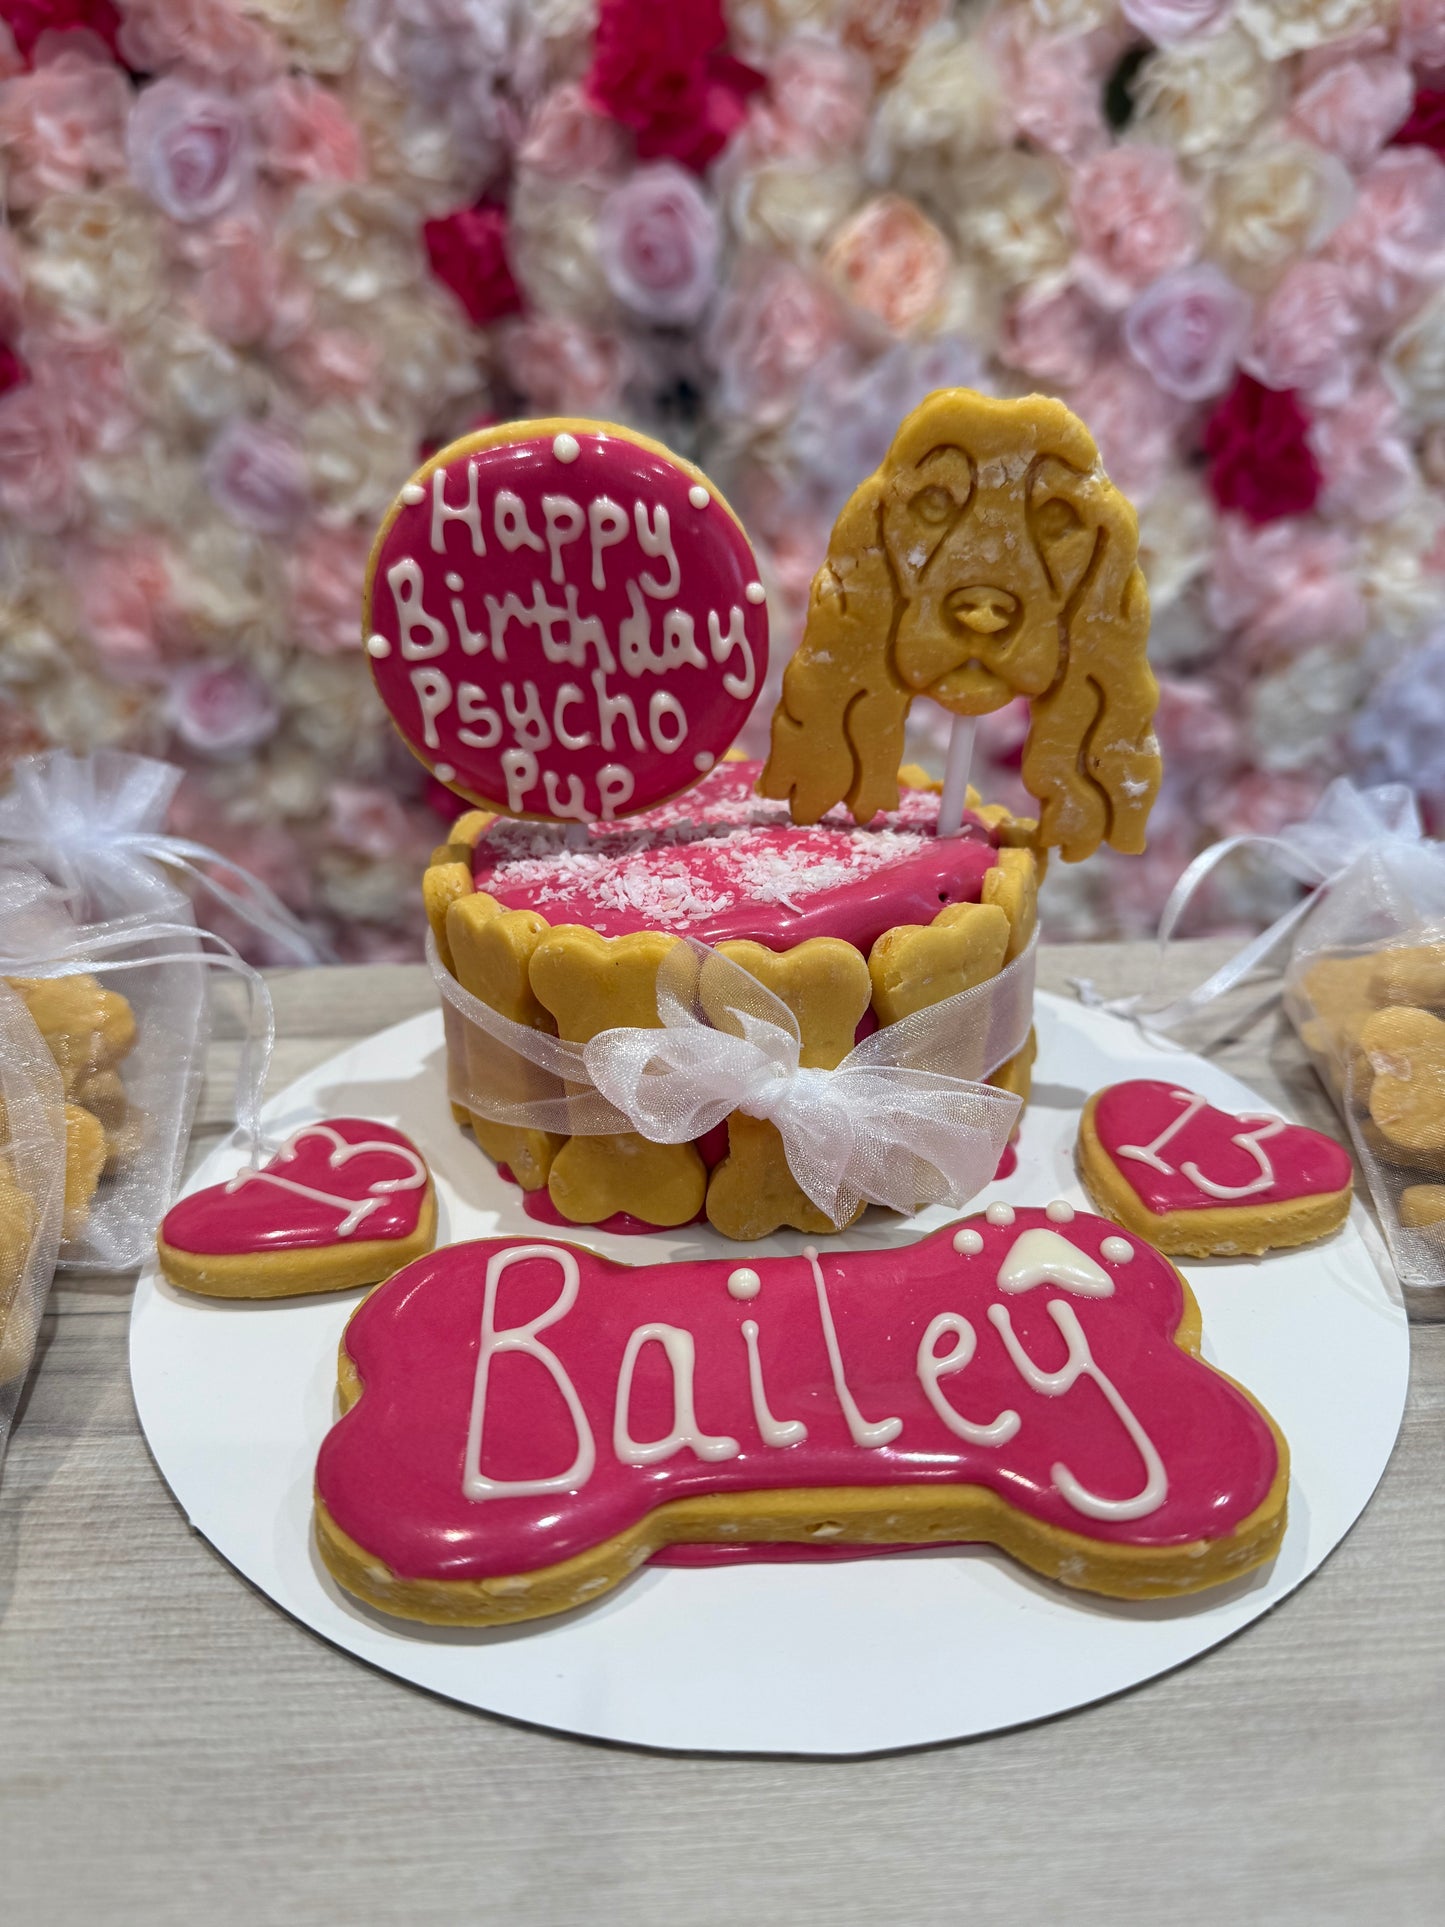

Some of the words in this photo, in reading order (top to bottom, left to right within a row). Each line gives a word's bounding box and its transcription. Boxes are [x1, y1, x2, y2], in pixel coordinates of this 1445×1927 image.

[430, 460, 680, 599] Happy
[387, 558, 756, 699] Birthday
[410, 667, 688, 754] Psycho
[501, 747, 635, 822] Pup
[225, 1126, 427, 1236] 13
[1116, 1090, 1286, 1199] 13
[462, 1244, 1168, 1523] Bailey
